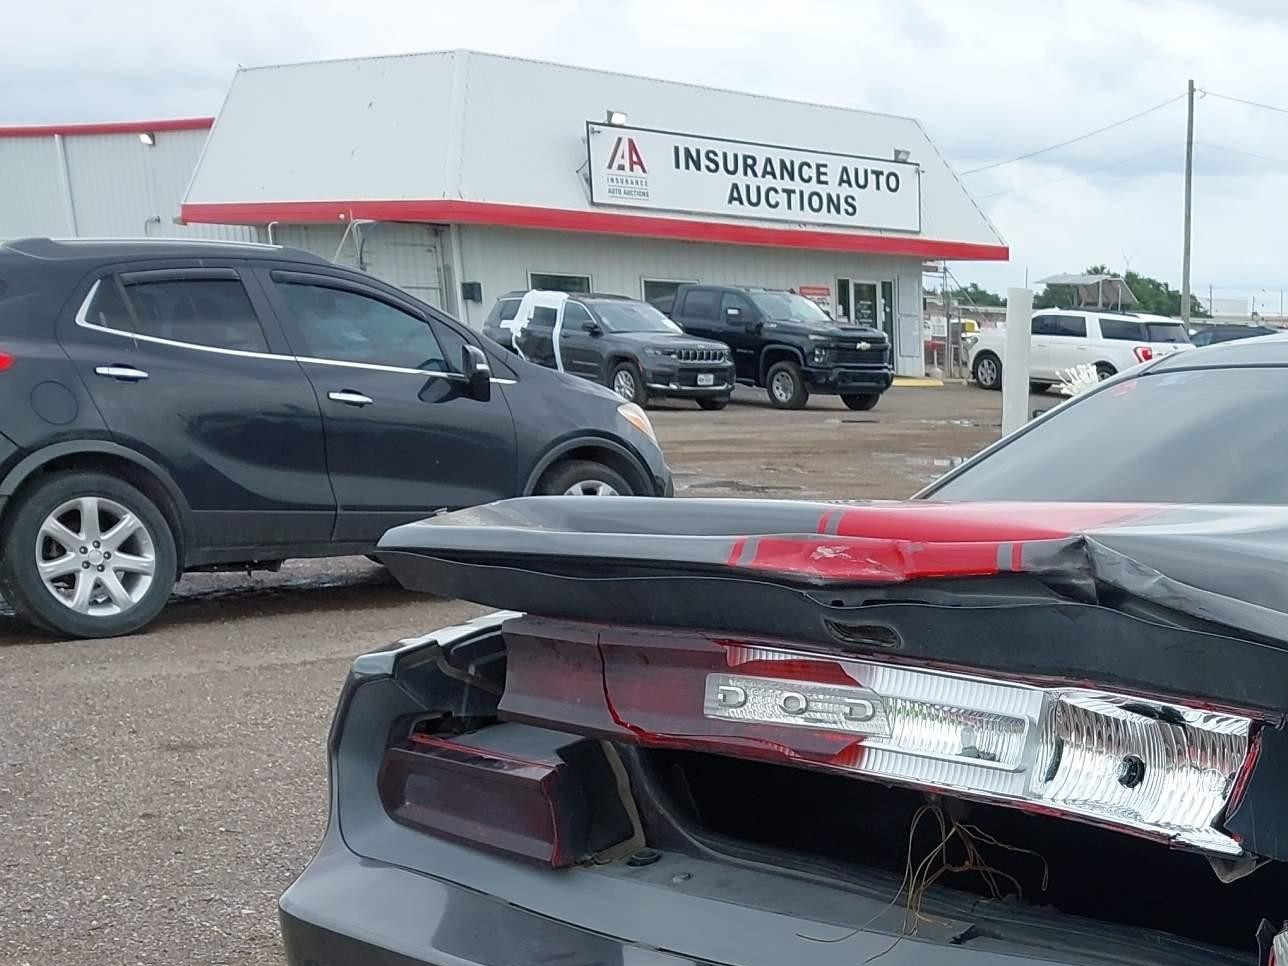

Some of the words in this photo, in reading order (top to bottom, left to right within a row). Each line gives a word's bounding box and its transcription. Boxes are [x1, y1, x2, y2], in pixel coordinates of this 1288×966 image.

[607, 176, 648, 187] INSURANCE
[673, 145, 829, 186] INSURANCE
[838, 166, 900, 193] AUTO
[727, 182, 857, 217] AUCTIONS
